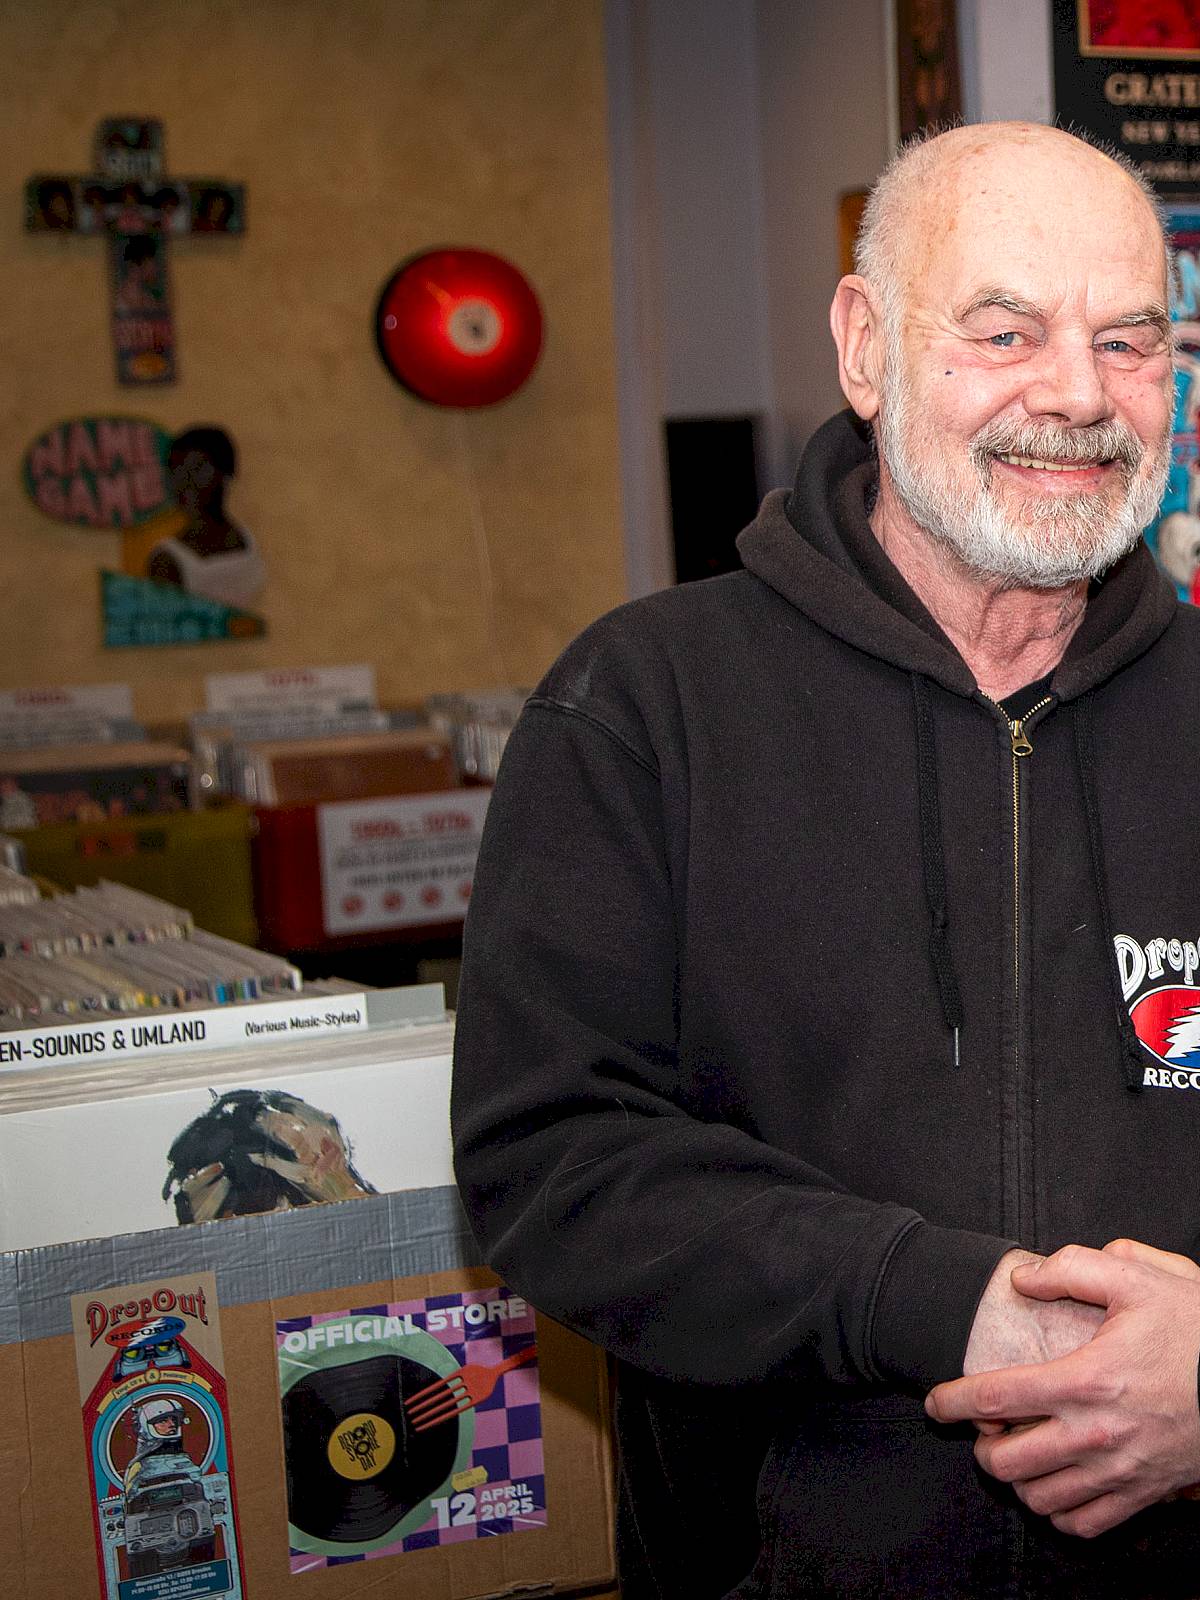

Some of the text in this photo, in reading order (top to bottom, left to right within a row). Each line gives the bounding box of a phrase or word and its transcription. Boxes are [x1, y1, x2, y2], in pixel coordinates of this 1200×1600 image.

[0, 1009, 361, 1063] EN-SOUNDS & UMLAND (Various Music-Styles)
[85, 1286, 208, 1348] DropOut
[283, 1298, 527, 1353] OFFICIAL STORE
[359, 1455, 378, 1471] DAY
[430, 1493, 477, 1528] 12
[480, 1484, 533, 1504] APRIL
[480, 1499, 535, 1521] 2025
